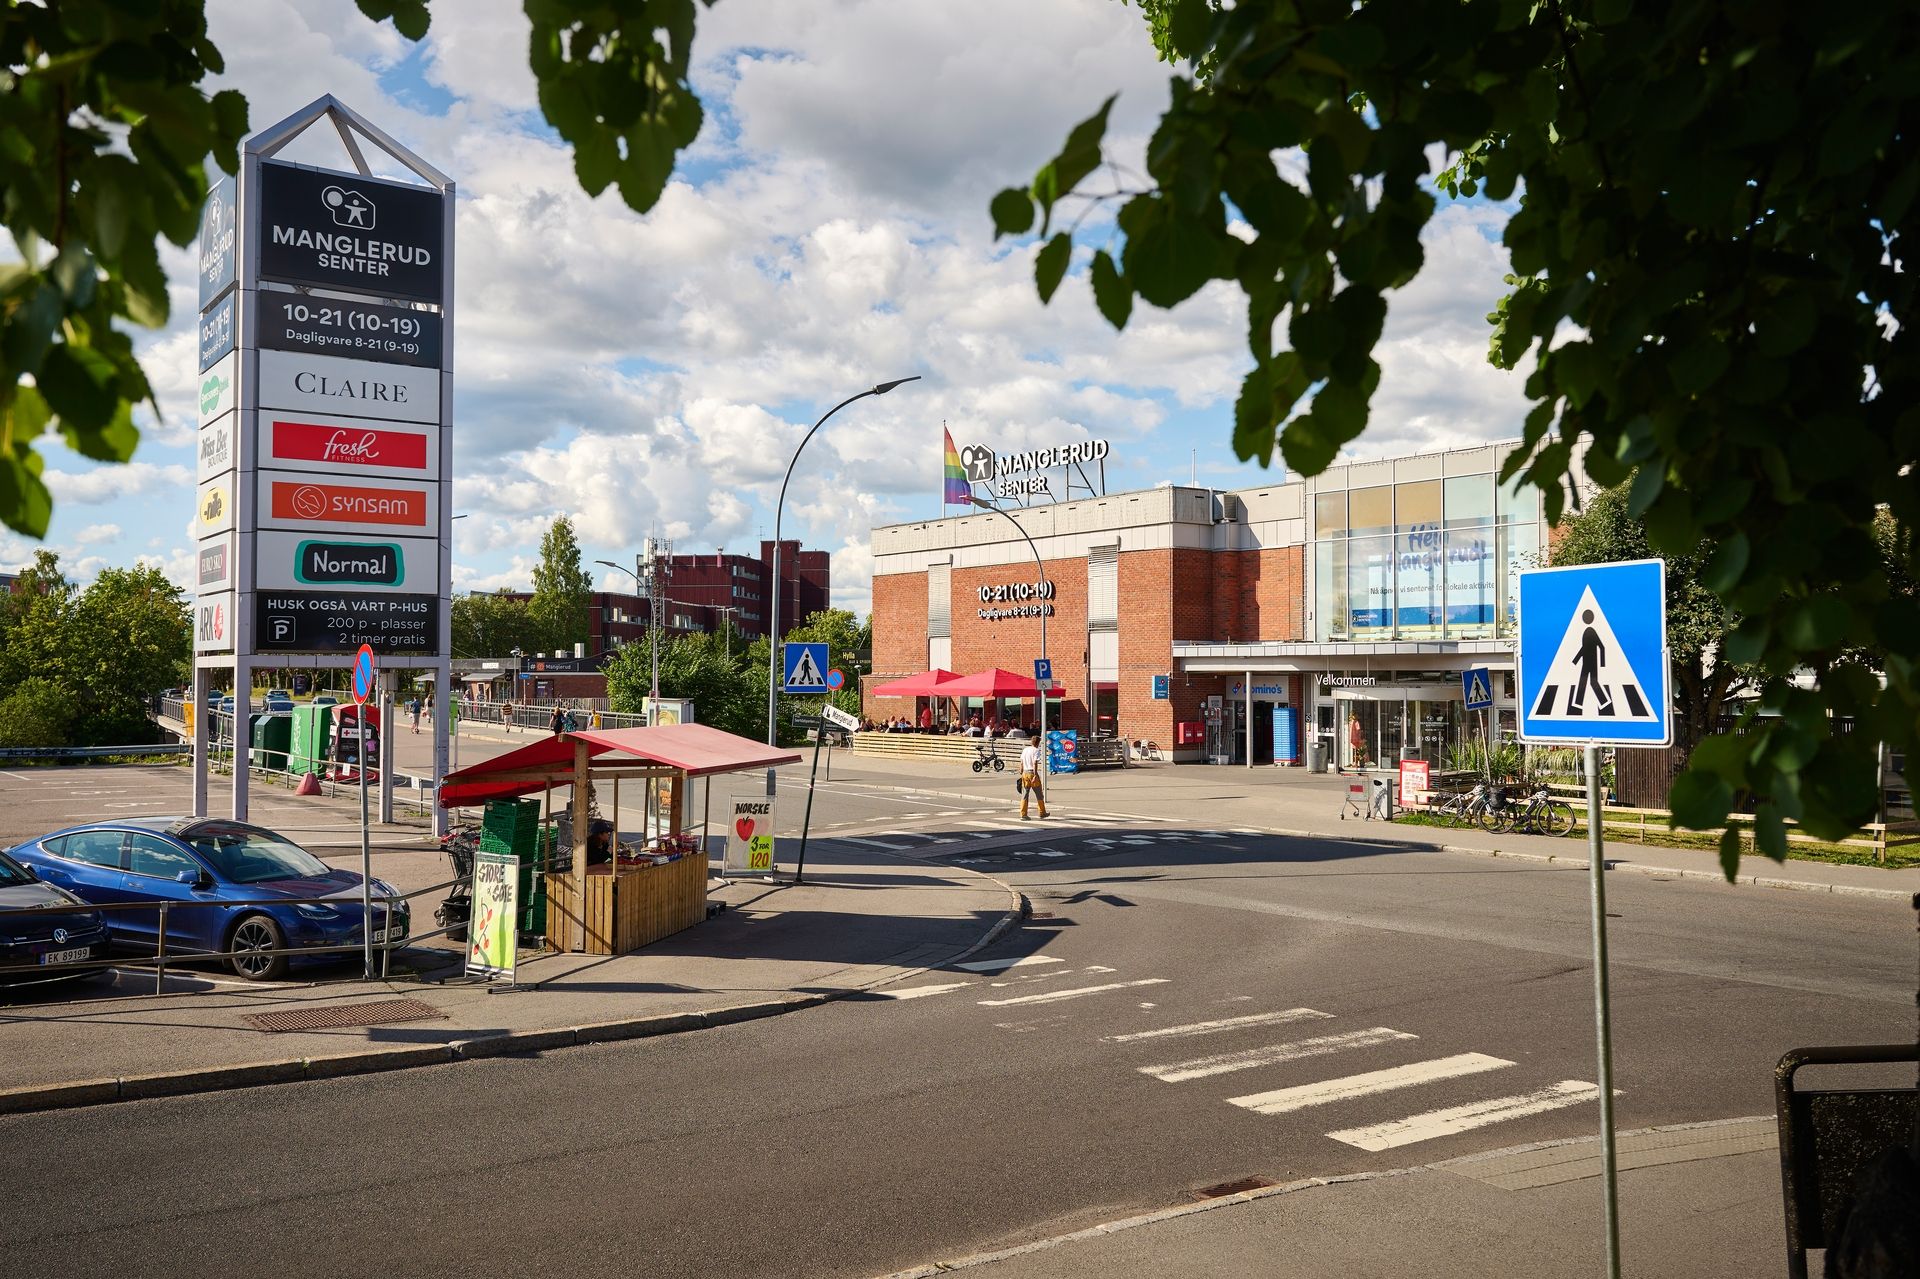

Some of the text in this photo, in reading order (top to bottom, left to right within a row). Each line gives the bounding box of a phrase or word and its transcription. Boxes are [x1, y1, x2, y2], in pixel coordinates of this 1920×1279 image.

[273, 225, 431, 266] MANGLERUD
[318, 253, 389, 277] SENTER
[283, 304, 420, 338] 10-21 (10-19)
[286, 328, 420, 355] Dagligvare 8-21 (9-19)
[294, 371, 408, 403] CLAIRE
[323, 429, 380, 460] fresh
[331, 455, 366, 463] FITNESS
[999, 439, 1108, 476] MANGLERUD
[998, 477, 1048, 497] SENTER
[332, 495, 408, 515] SYNSAM
[313, 550, 386, 575] Normal
[976, 580, 1053, 601] 10-21 (10-19)
[267, 599, 428, 613] HUSK OGSÅ VÅRT P-HUS
[977, 608, 1012, 619] Dagligvare
[1013, 606, 1029, 616] 8-21
[200, 605, 214, 641] ARK
[327, 617, 355, 628] 200
[359, 618, 367, 630] p
[381, 617, 426, 630] plasser
[339, 633, 426, 646] 2 timer gratis
[1039, 662, 1048, 677] P
[1314, 673, 1376, 686] Velkommen
[735, 803, 770, 815] NORSKE
[751, 836, 759, 852] 3
[751, 852, 770, 868] 120
[478, 863, 506, 883] STORE
[48, 948, 88, 964] EK 89199
